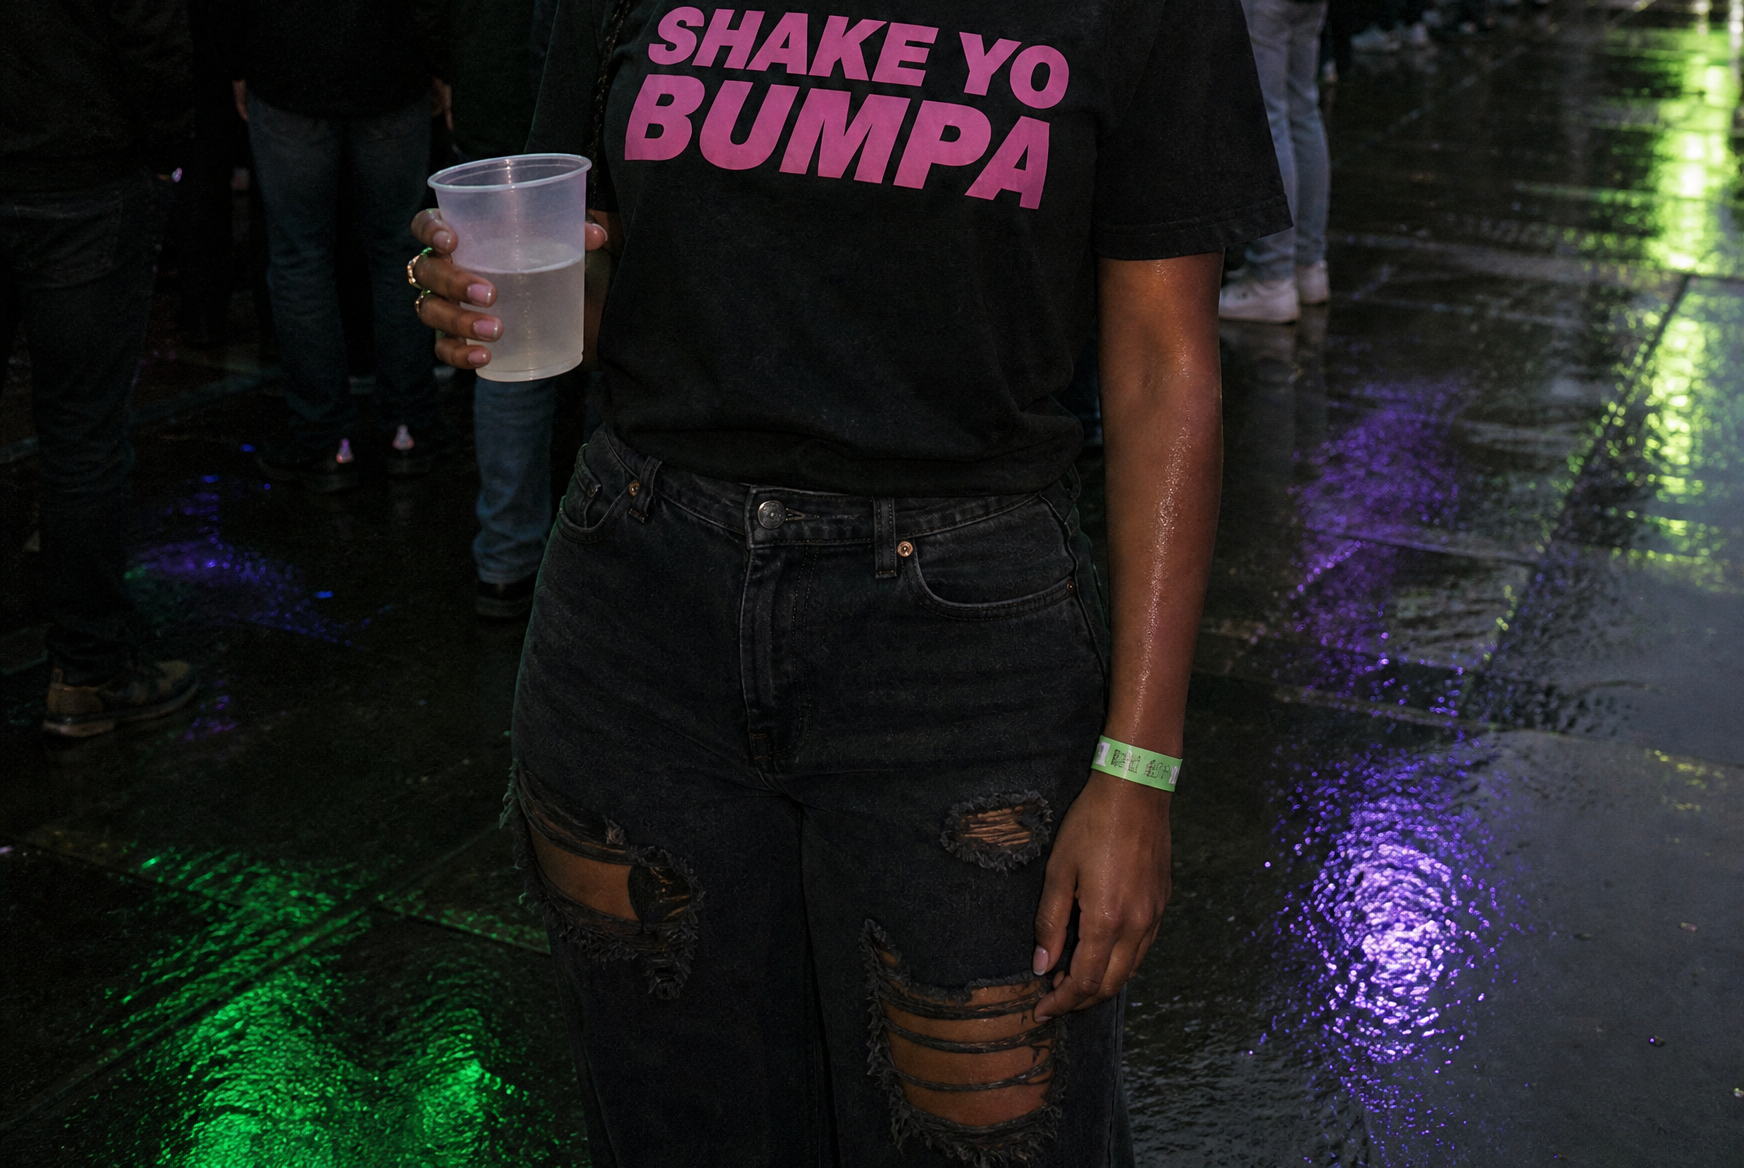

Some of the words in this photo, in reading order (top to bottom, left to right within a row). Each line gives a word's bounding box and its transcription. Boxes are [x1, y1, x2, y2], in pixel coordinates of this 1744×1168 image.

[647, 5, 940, 88] SHAKE
[958, 31, 1070, 110] YO
[624, 73, 1051, 211] BUMPA
